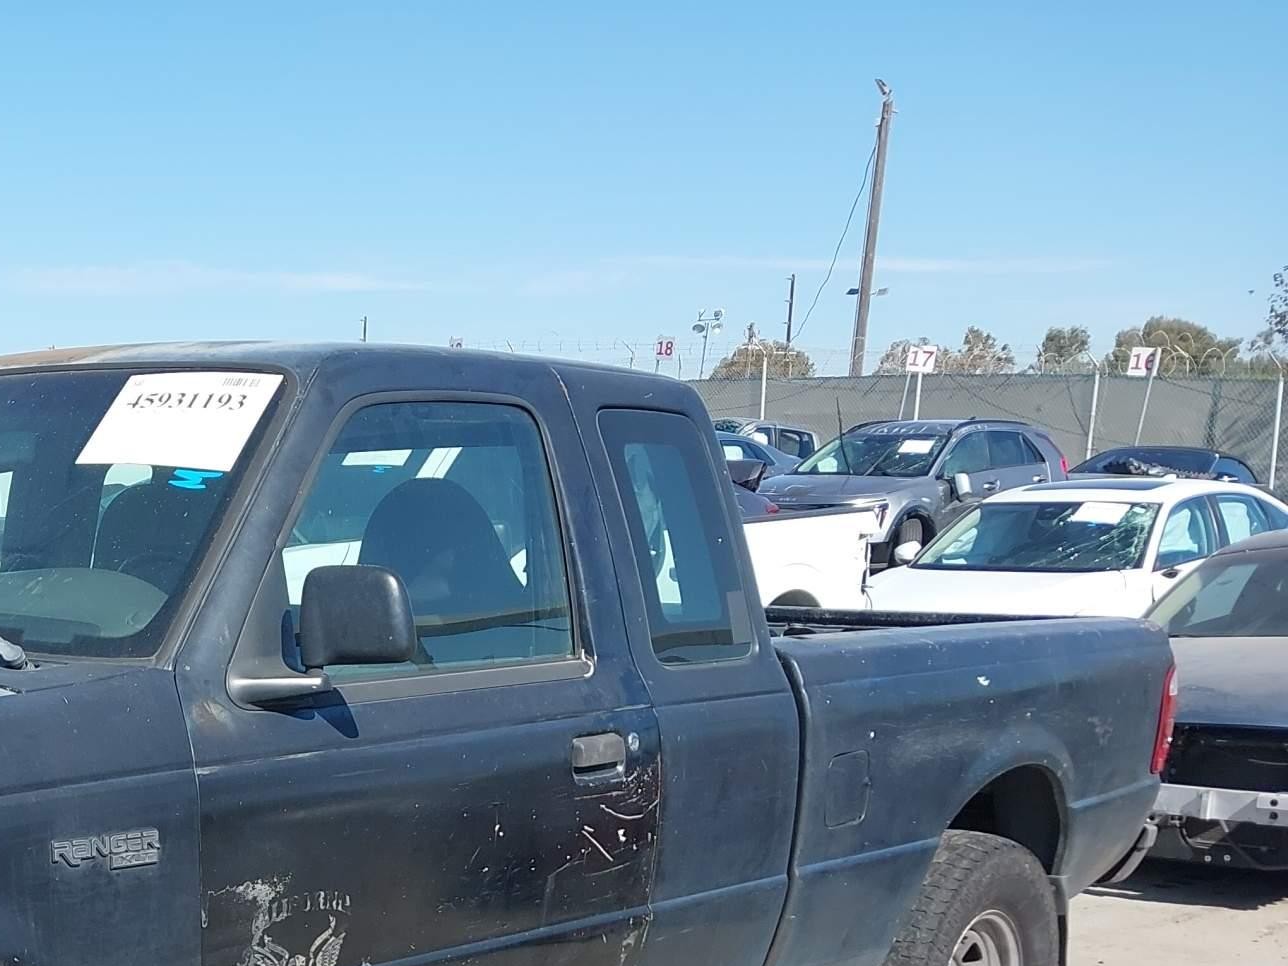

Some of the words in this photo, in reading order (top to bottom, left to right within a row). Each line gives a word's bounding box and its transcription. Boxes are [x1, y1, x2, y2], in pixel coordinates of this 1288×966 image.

[656, 341, 674, 356] 18
[908, 350, 935, 367] 17
[126, 392, 248, 411] 45931193
[50, 828, 160, 868] RANGER
